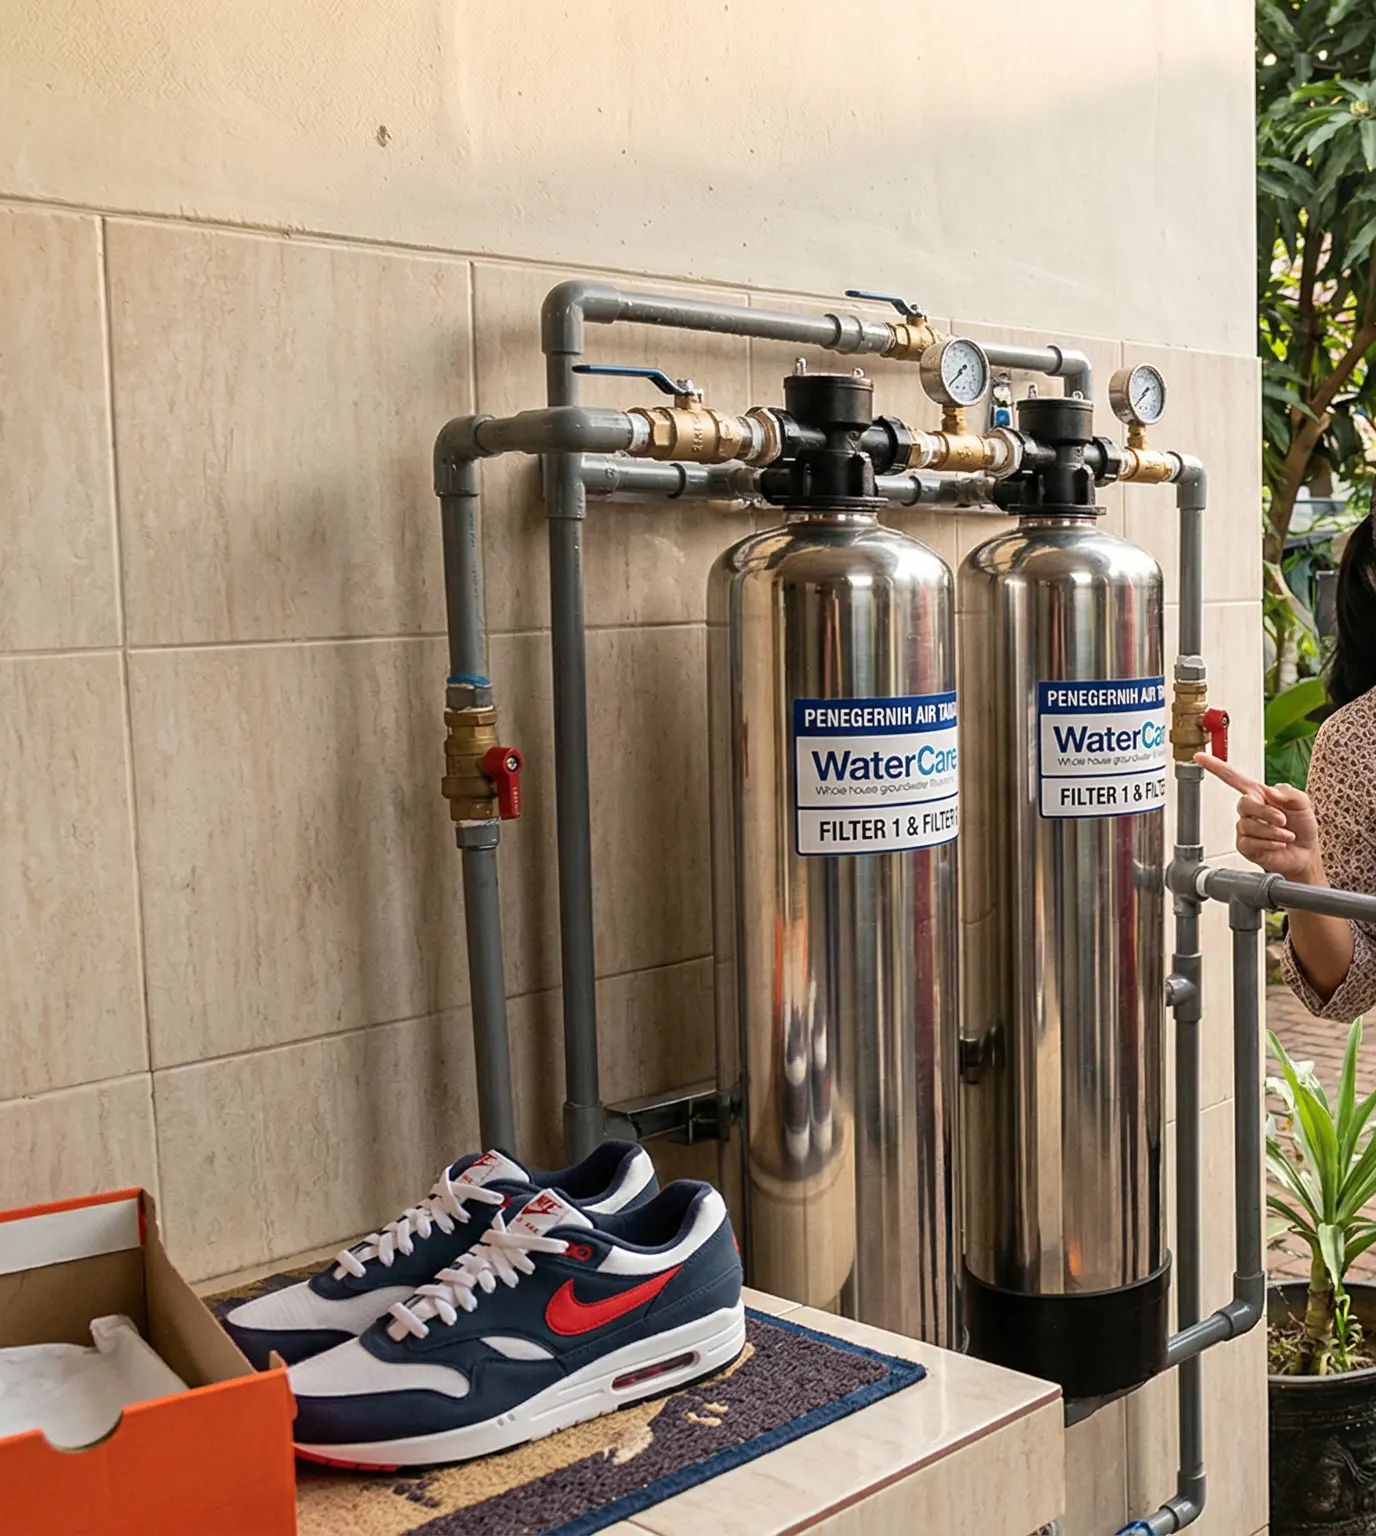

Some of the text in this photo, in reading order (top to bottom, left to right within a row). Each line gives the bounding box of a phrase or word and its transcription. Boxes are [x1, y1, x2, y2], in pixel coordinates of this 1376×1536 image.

[1047, 688, 1138, 707] PENEGERNIH
[804, 707, 912, 727] PENEGERNIH
[916, 704, 937, 724] AIR
[1060, 786, 1117, 806] FILTER
[1121, 785, 1129, 803] 1
[1132, 783, 1143, 802] &
[819, 819, 886, 842] FILTER
[892, 818, 900, 838] 1
[907, 816, 919, 837] &
